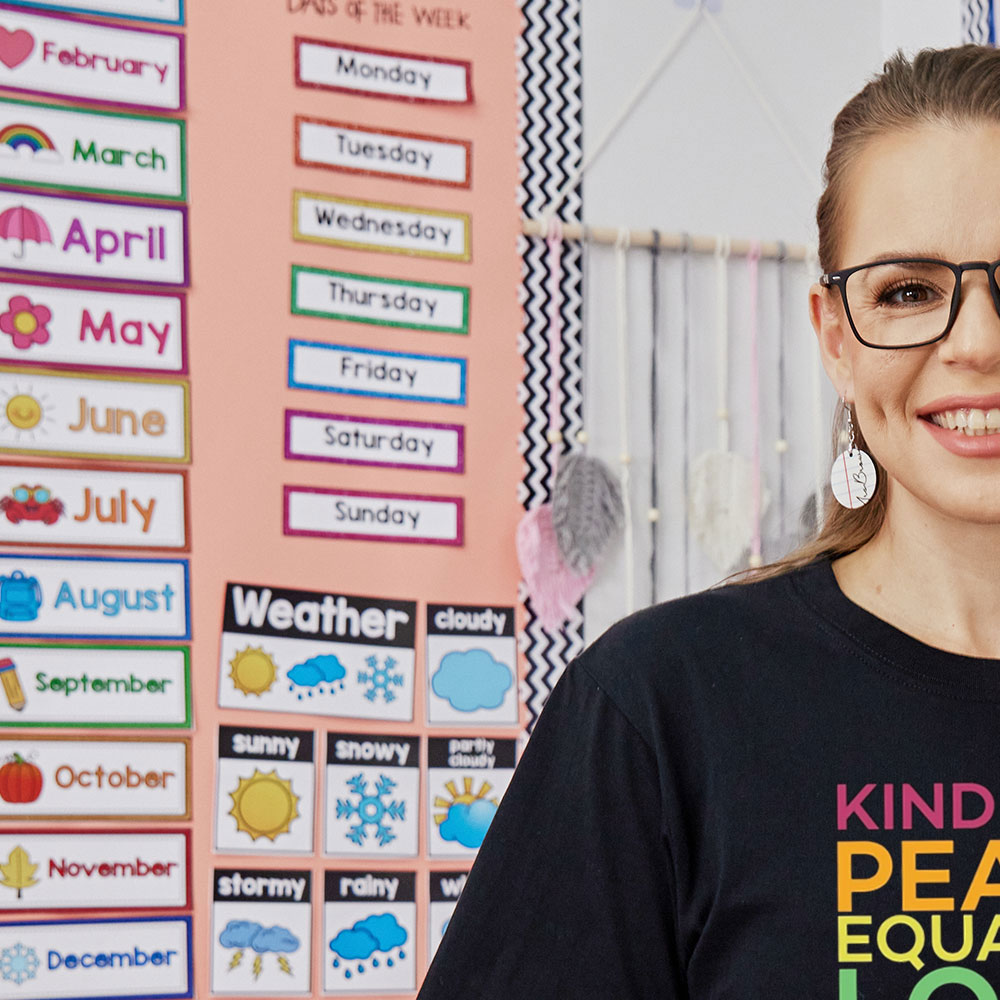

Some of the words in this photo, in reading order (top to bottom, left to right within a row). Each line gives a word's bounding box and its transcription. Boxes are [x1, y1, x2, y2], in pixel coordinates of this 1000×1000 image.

[373, 1, 402, 25] THE
[413, 5, 470, 29] WEEK
[43, 40, 168, 83] February
[336, 55, 431, 90] Monday
[73, 139, 166, 171] March
[337, 134, 433, 169] Tuesday
[62, 218, 166, 263] April
[314, 207, 452, 246] Wednesday
[328, 281, 438, 316] Thursday
[79, 309, 170, 355] May
[340, 355, 418, 389] Friday
[68, 397, 166, 437] June
[324, 424, 434, 456] Saturday
[74, 487, 156, 534] July
[335, 500, 421, 529] Sunday
[54, 581, 175, 617] August
[233, 585, 410, 640] Weather
[435, 607, 507, 634] cloudy
[36, 671, 173, 697] September
[233, 732, 300, 760] sunny
[335, 736, 411, 764] snowy
[448, 752, 496, 769] cloudy
[55, 765, 175, 789] October
[49, 857, 177, 878] November
[218, 872, 306, 902] stormy
[340, 872, 400, 899] rainy
[48, 947, 177, 970] December
